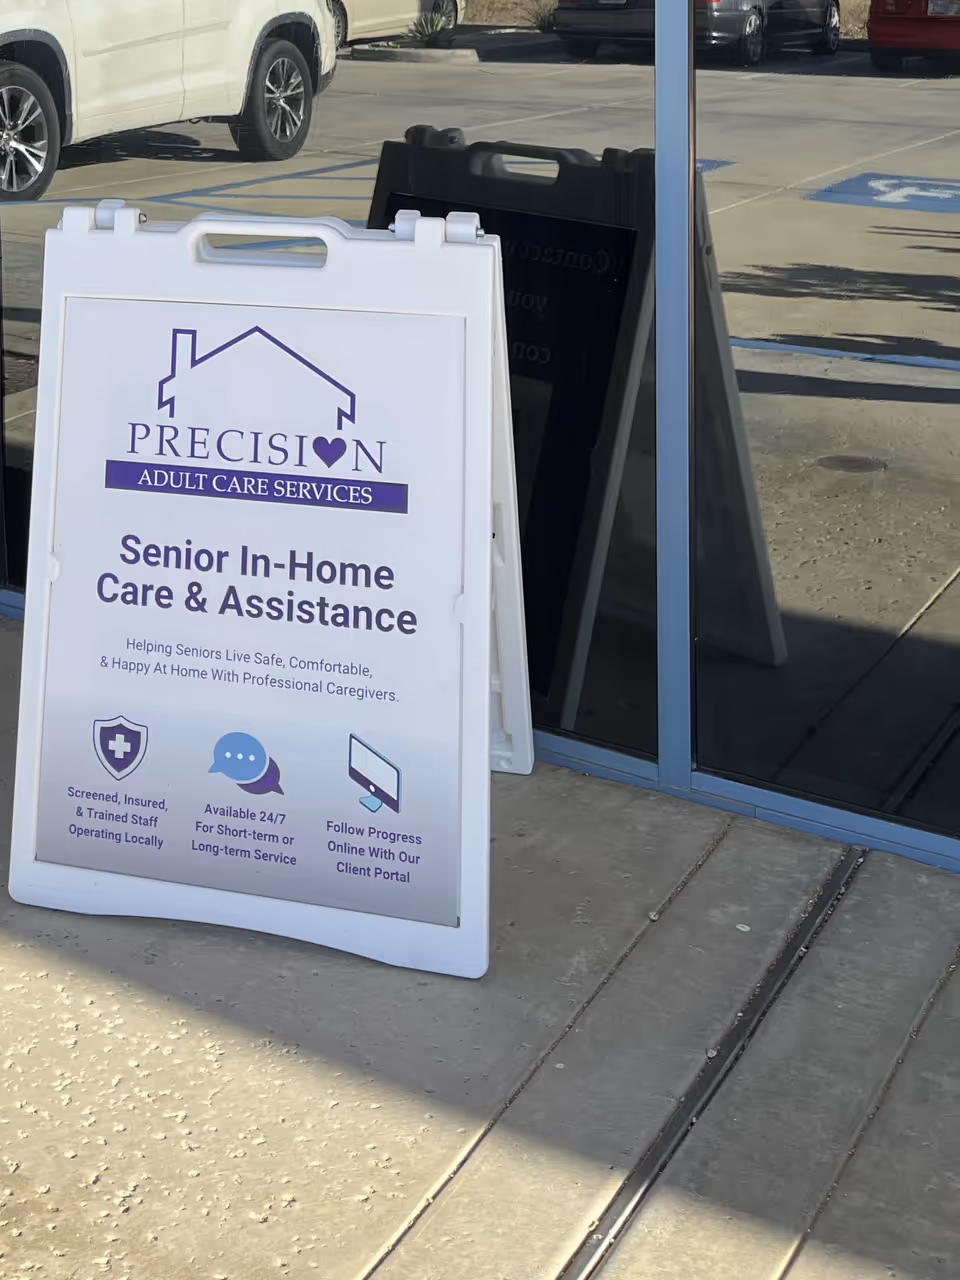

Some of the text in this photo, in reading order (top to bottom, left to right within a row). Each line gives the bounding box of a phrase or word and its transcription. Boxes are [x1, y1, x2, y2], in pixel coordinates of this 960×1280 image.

[138, 469, 373, 504] ADULT CARE SERVICES
[120, 534, 394, 590] Senior In-Home
[97, 572, 417, 635] Care & Assistance
[126, 638, 373, 679] Helping Seniors Live Safe, Comfortable,
[100, 656, 400, 703] & Happy At Home With Professional Caregivers.
[67, 786, 169, 811] Screened, Insured,
[75, 805, 159, 828] & Trained Staff
[204, 803, 286, 825] Available 24/7
[68, 824, 164, 850] Operating Locally
[195, 821, 295, 846] For Short-term or
[326, 820, 423, 847] Follow Progress
[191, 840, 297, 865] Long-term Service
[327, 840, 420, 865] Online With Our
[336, 861, 411, 883] Client Portal
